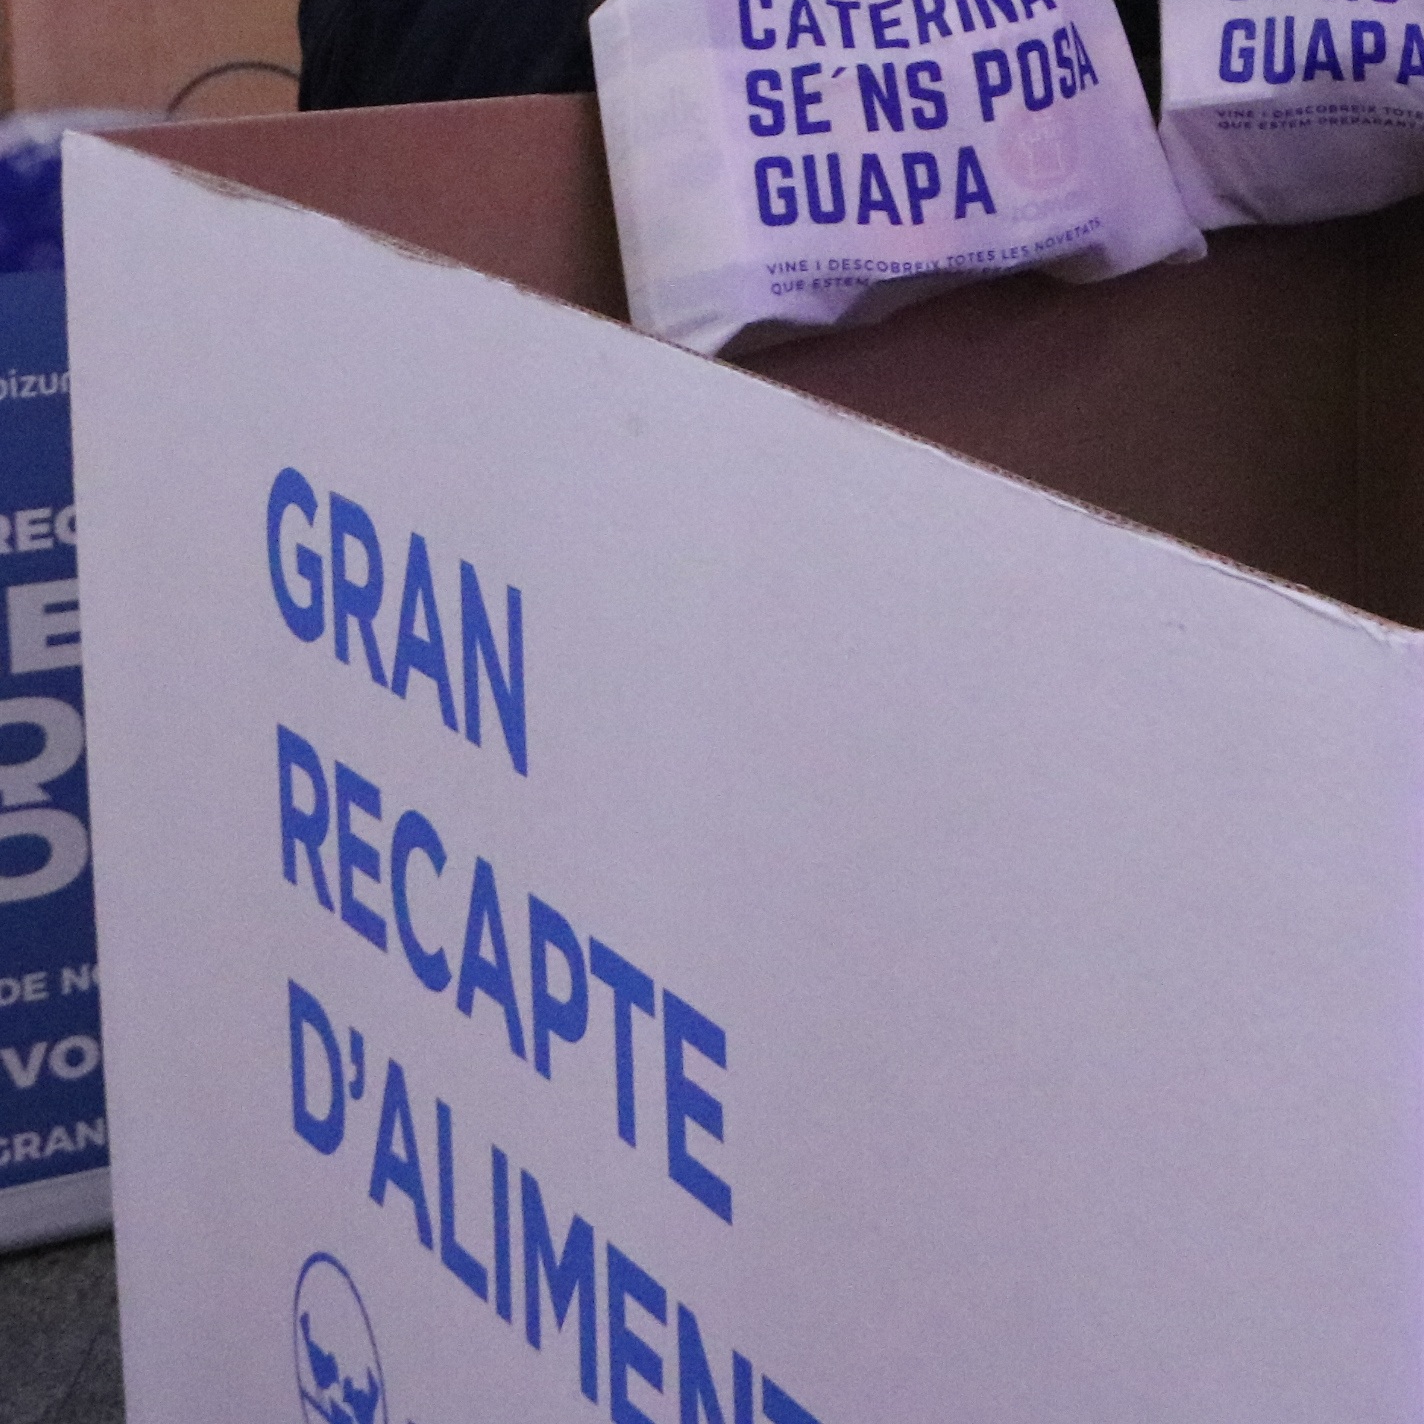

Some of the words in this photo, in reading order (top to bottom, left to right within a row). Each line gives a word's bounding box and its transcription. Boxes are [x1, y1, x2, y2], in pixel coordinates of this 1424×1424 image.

[744, 59, 949, 138] SE'NS
[973, 20, 1100, 123] POSA
[753, 145, 997, 228] GUAPA
[766, 260, 809, 275] VINE
[946, 250, 995, 268] TOTES
[1002, 245, 1029, 261] LES
[771, 279, 805, 295] QUE
[265, 466, 529, 778] GRAN
[276, 721, 733, 1226] RECAPTE
